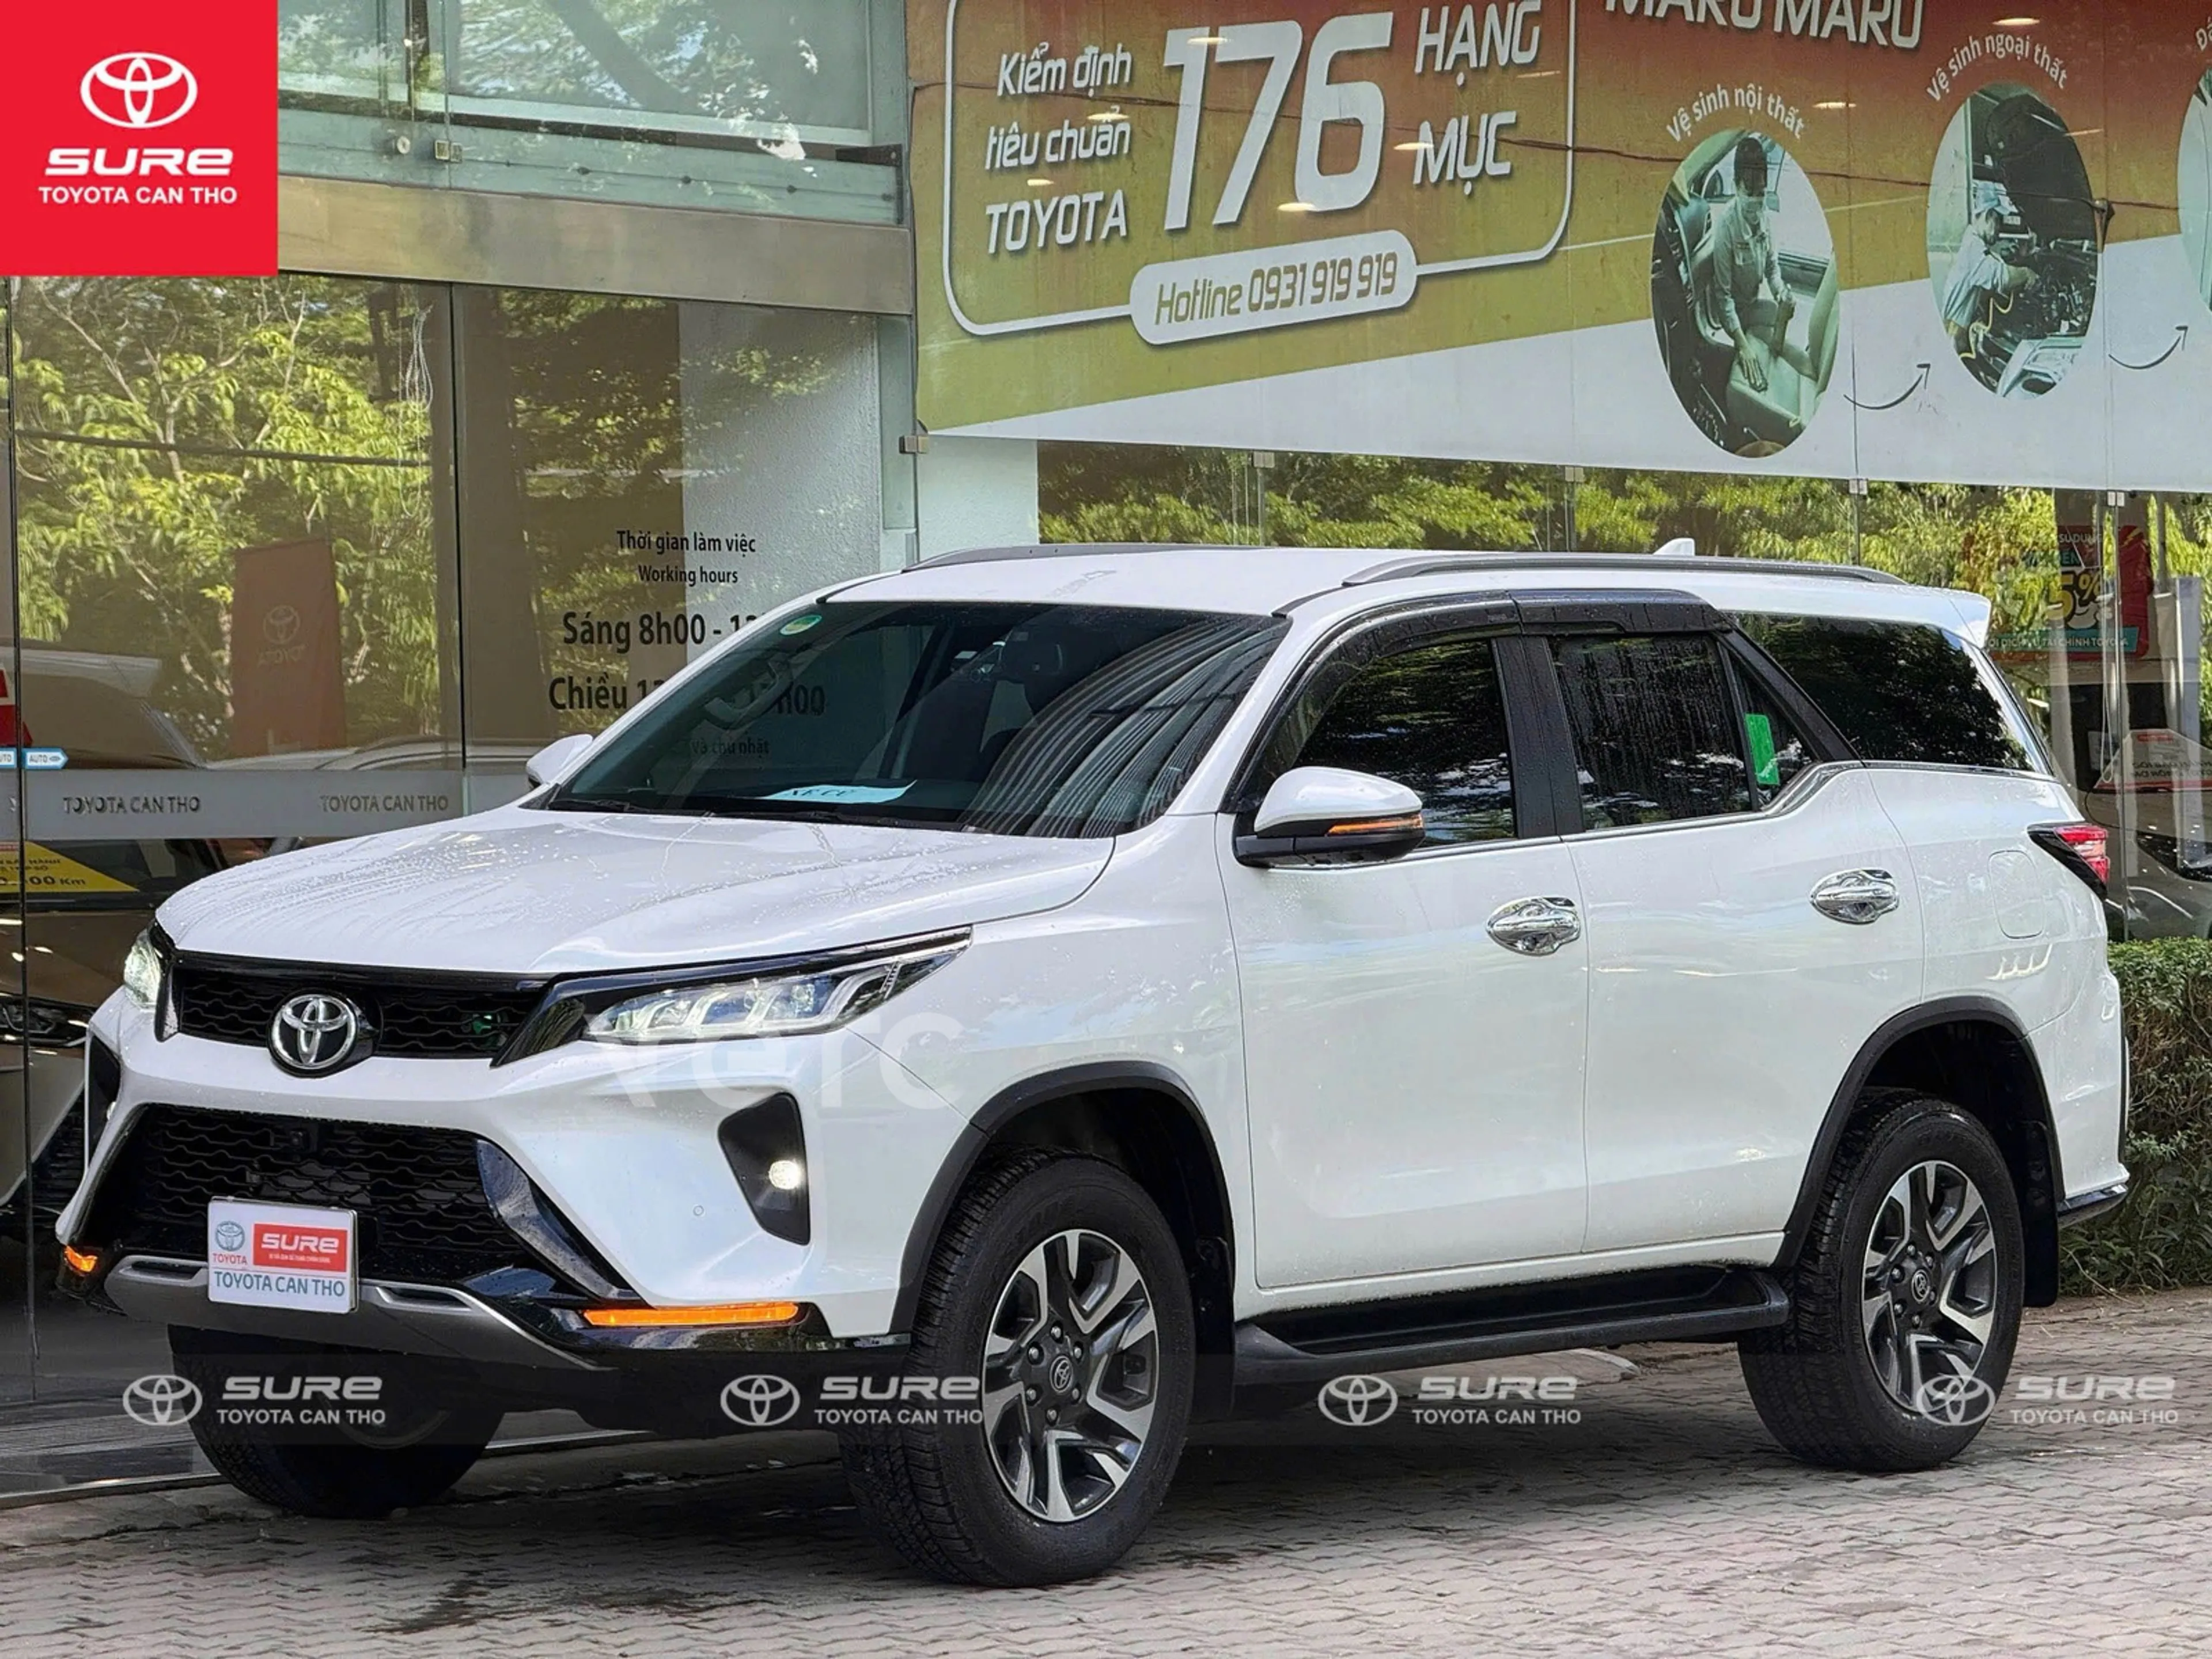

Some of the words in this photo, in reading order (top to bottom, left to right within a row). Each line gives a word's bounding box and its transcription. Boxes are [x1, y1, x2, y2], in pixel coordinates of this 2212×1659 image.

[997, 41, 1066, 96] Kiểm
[1073, 43, 1132, 97] định
[1415, 0, 1541, 86] HẠNG
[1926, 67, 1949, 101] Vệ
[1948, 36, 1982, 77] sinh
[1984, 33, 2030, 60] ngoại
[2033, 43, 2067, 89] thất
[985, 121, 1040, 170] tiêu
[1045, 105, 1130, 162] chuẩn
[1162, 12, 1393, 230] 176
[1666, 107, 1692, 142] Vệ
[1692, 84, 1729, 122] sinh
[1734, 82, 1763, 115] nội
[1767, 93, 1805, 139] thất
[1413, 111, 1517, 195] MỤC
[986, 189, 1127, 253] TOYOTA
[1154, 278, 1243, 325] Hotline
[1247, 262, 1308, 312] 0931
[1310, 257, 1353, 305] 919
[1356, 252, 1397, 298] 919
[616, 531, 652, 550] Thời
[656, 532, 690, 555] gian
[694, 532, 721, 551] làm
[725, 533, 756, 558] việc
[638, 565, 696, 587] Working
[700, 566, 738, 583] hours
[563, 612, 631, 654] Sáng
[639, 612, 705, 645] 8h00
[549, 672, 627, 710] Chiều
[63, 797, 127, 814] TOYOTA
[130, 797, 164, 813] CAN
[168, 797, 200, 811] THO
[320, 795, 380, 812] TOYOTA
[382, 795, 414, 811] CAN
[418, 795, 449, 811] THO
[213, 1252, 248, 1265] TOYOTA
[214, 1271, 272, 1291] TOYOTA
[275, 1276, 308, 1294] CAN
[312, 1279, 345, 1297] THO
